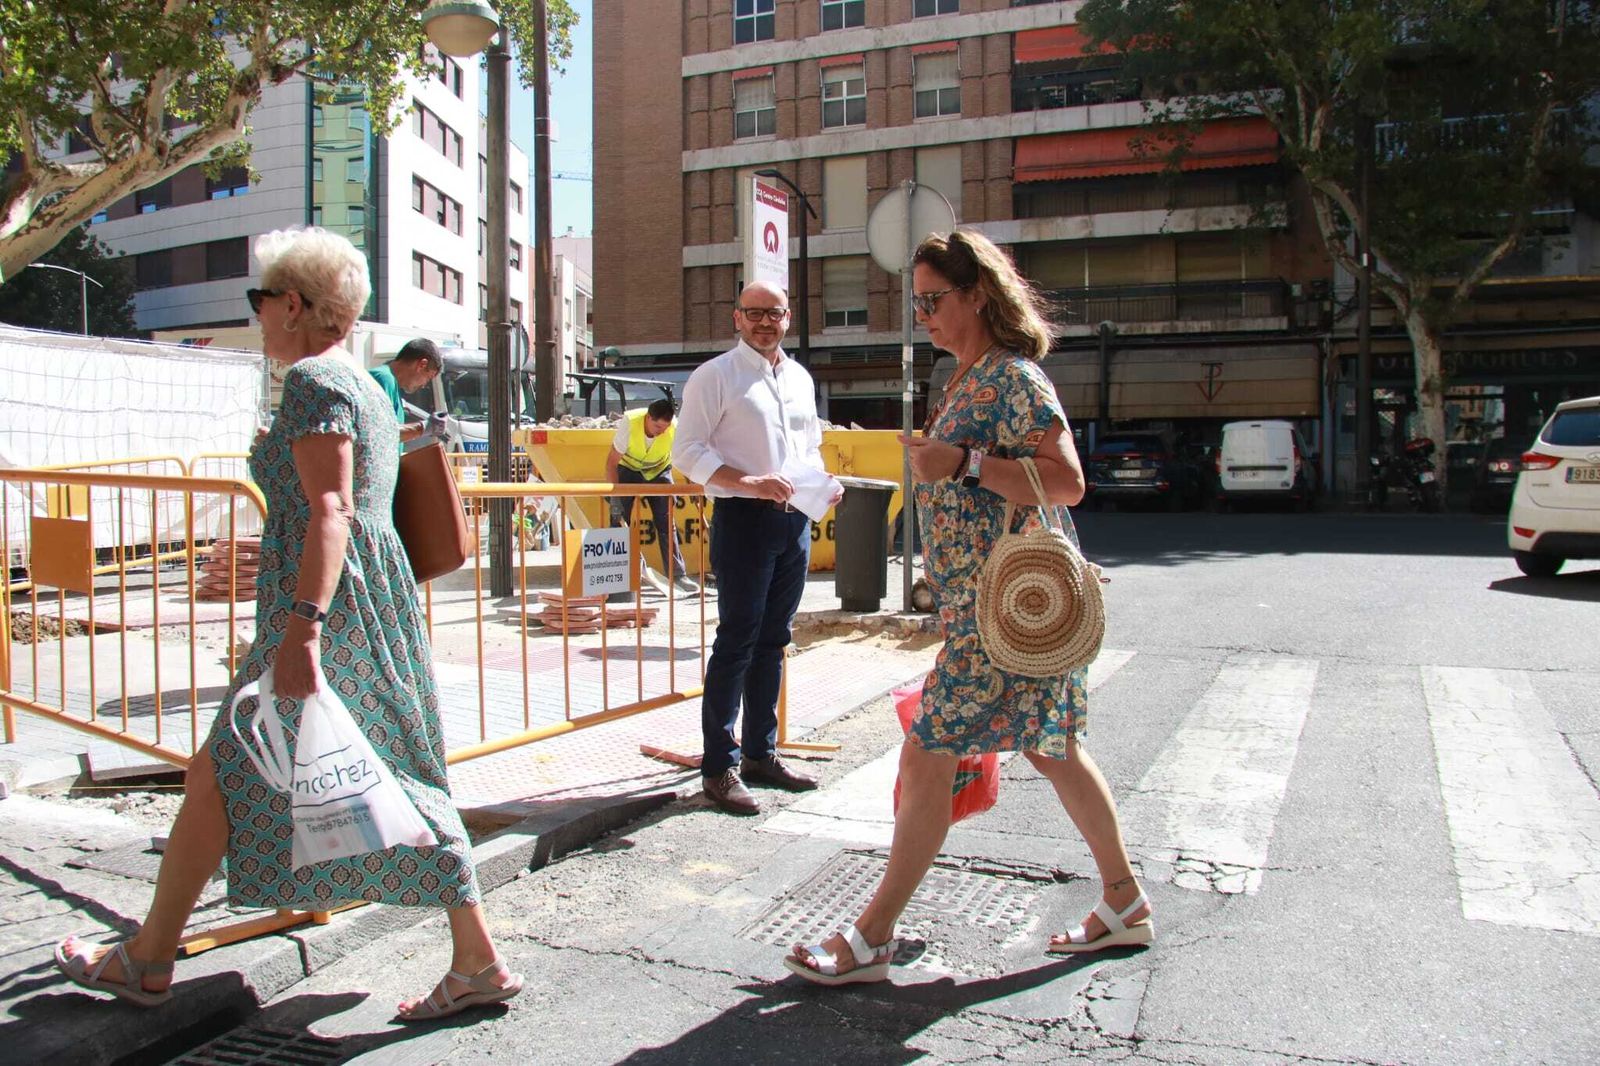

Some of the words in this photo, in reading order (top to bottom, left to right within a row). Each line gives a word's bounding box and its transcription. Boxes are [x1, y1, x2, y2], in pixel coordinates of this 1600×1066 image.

[584, 538, 628, 557] PROVIAL
[596, 575, 605, 585] 619
[605, 574, 614, 583] 472
[614, 573, 623, 583] 758
